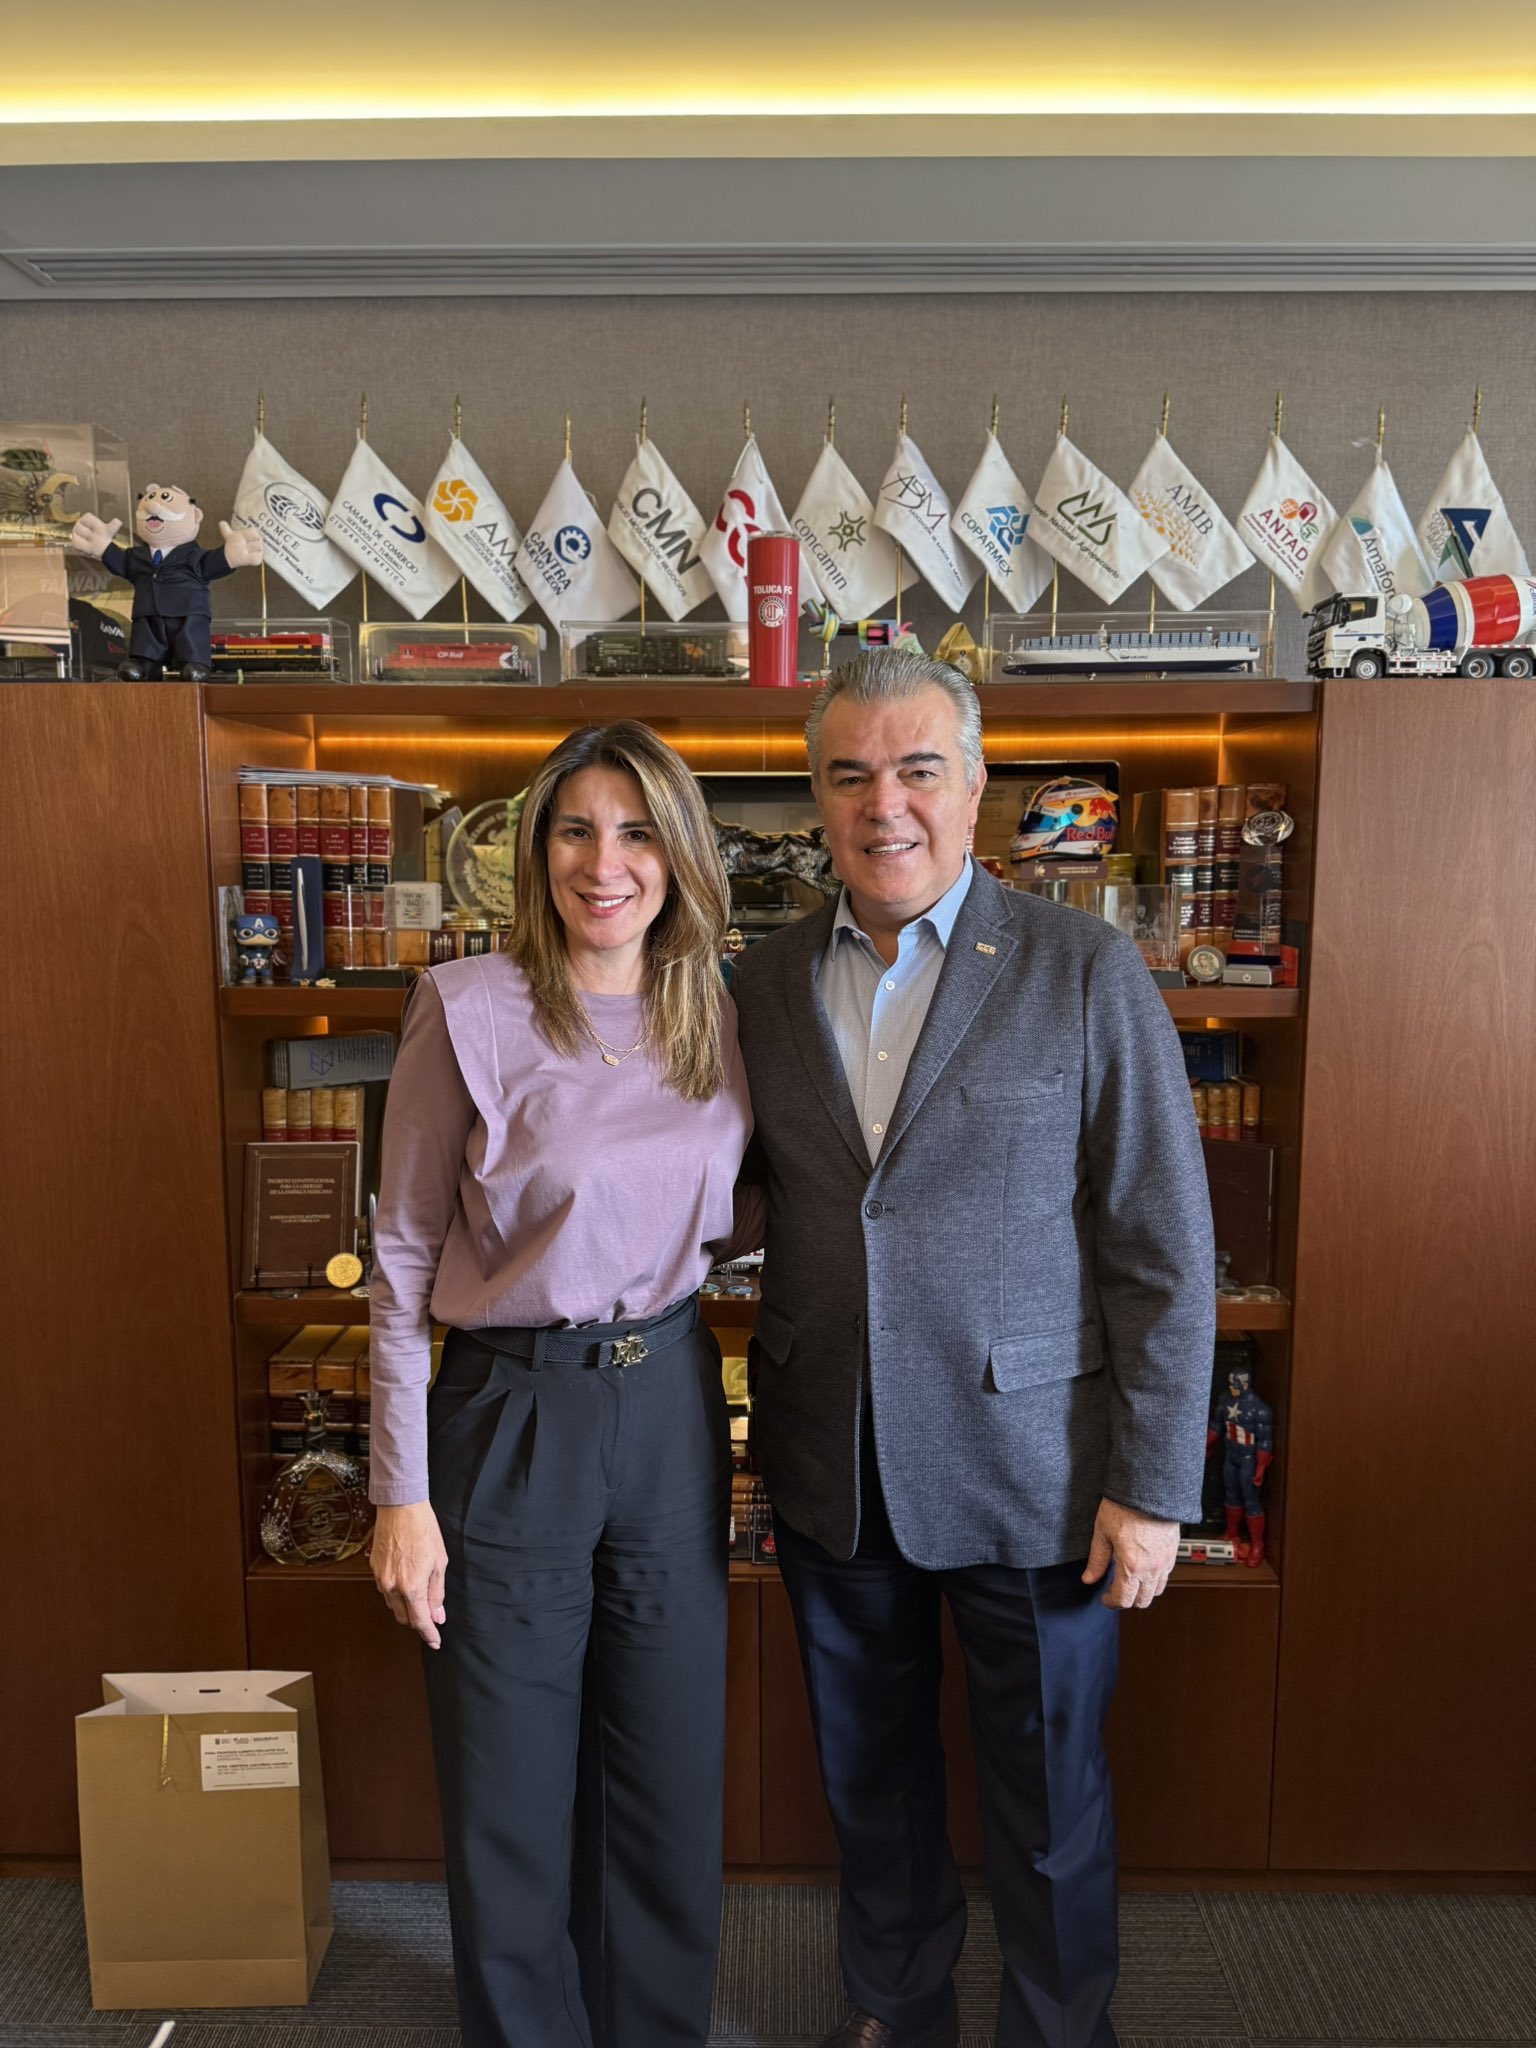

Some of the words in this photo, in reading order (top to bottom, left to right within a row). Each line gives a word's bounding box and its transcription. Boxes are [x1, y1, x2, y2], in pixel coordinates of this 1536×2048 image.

[258, 512, 300, 551] COMCE
[632, 488, 701, 575] CMN
[1048, 517, 1078, 541] Nacional
[1166, 484, 1214, 535] AMIB
[329, 516, 360, 544] CIUDAD
[361, 545, 372, 556] DE
[372, 529, 384, 541] DE
[383, 539, 419, 574] COMERCIO
[523, 538, 546, 570] NUEVO
[795, 518, 848, 591] concamin
[960, 512, 1014, 578] COPARMEX
[1259, 508, 1309, 562] ANTAD
[530, 531, 572, 591] CAINTRA
[753, 585, 782, 595] TOLUCA
[784, 585, 793, 595] FC
[1066, 825, 1096, 841] Red
